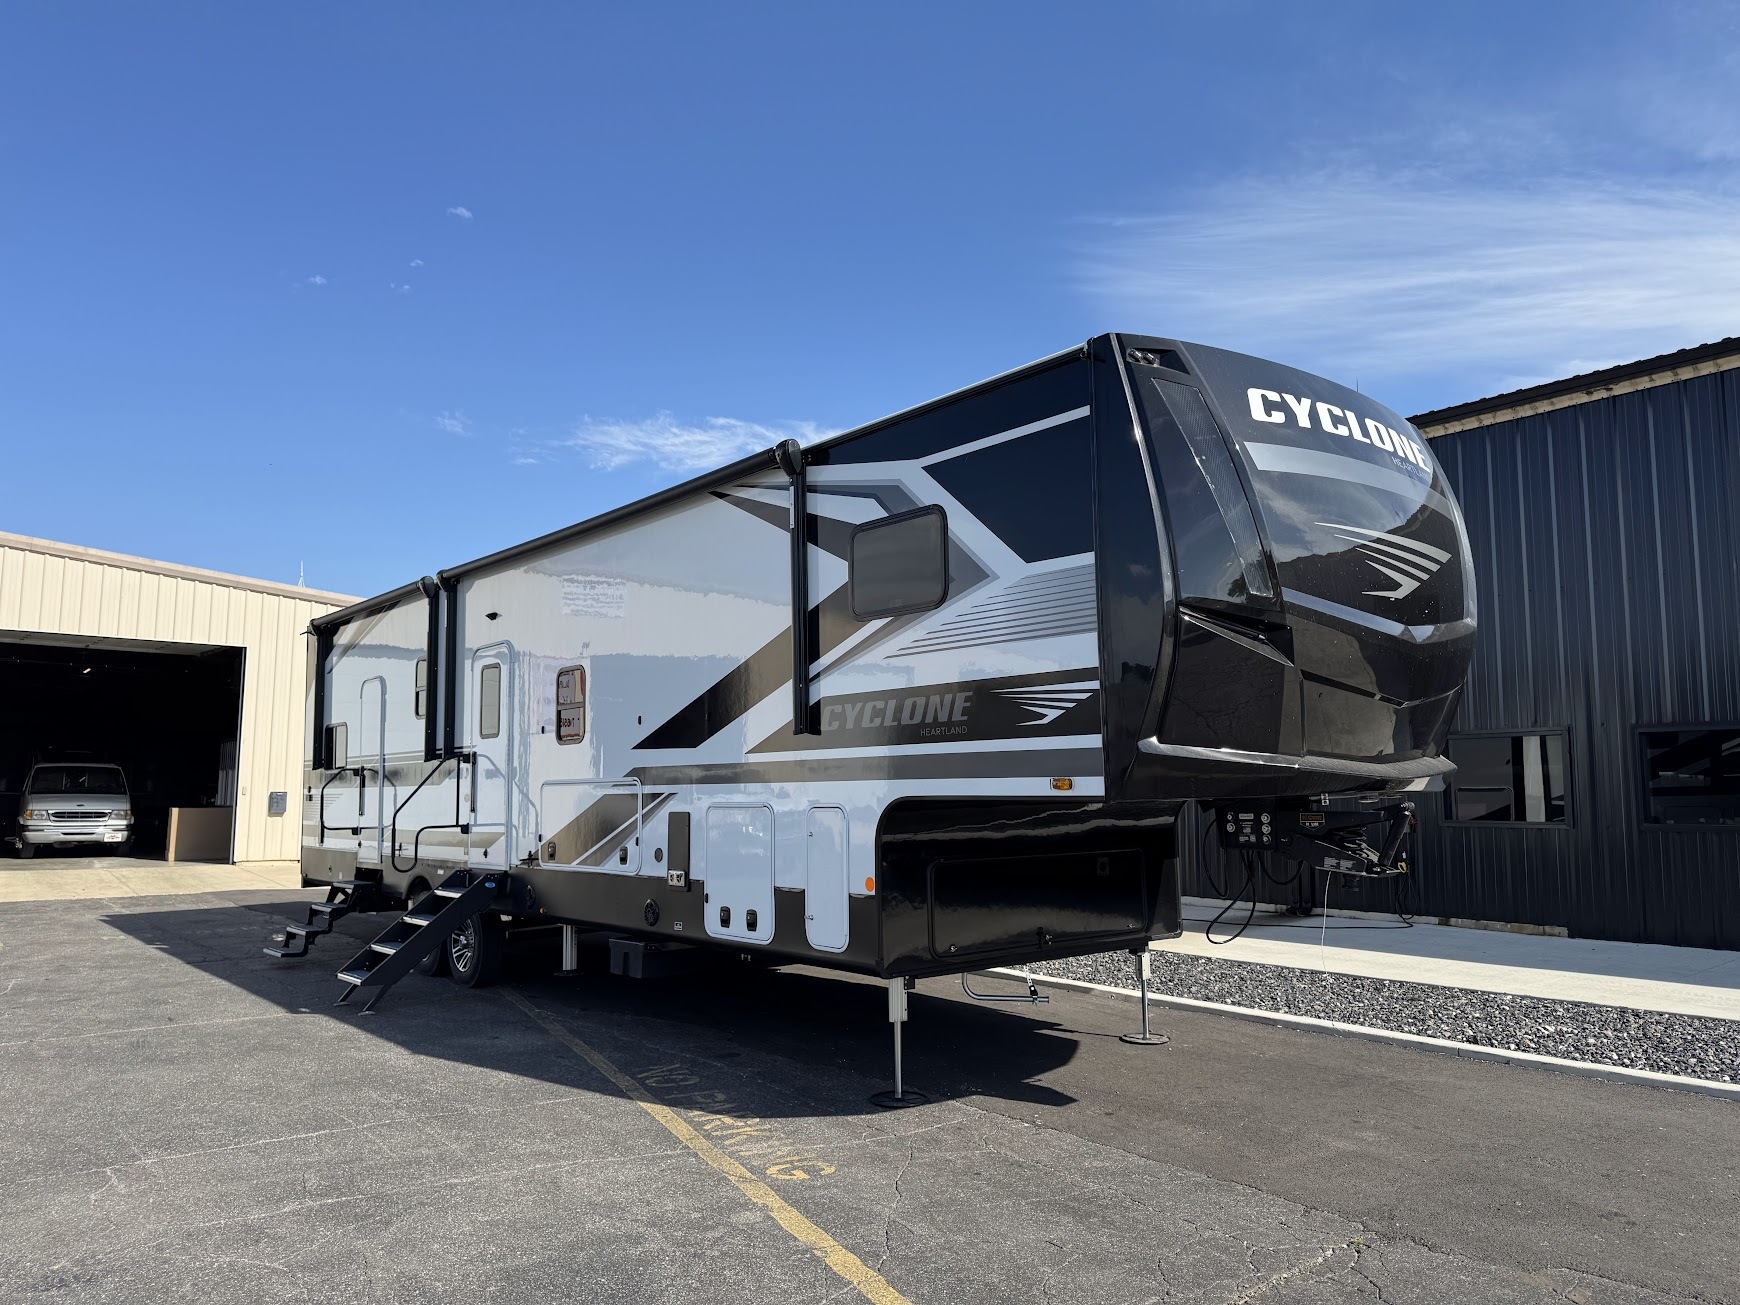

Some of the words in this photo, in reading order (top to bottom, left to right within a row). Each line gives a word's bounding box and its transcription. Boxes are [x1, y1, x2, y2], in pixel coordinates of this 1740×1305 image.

[1247, 387, 1431, 473] CYCLONE
[821, 691, 973, 732] CYCLONE
[920, 726, 968, 737] HEARTLAND
